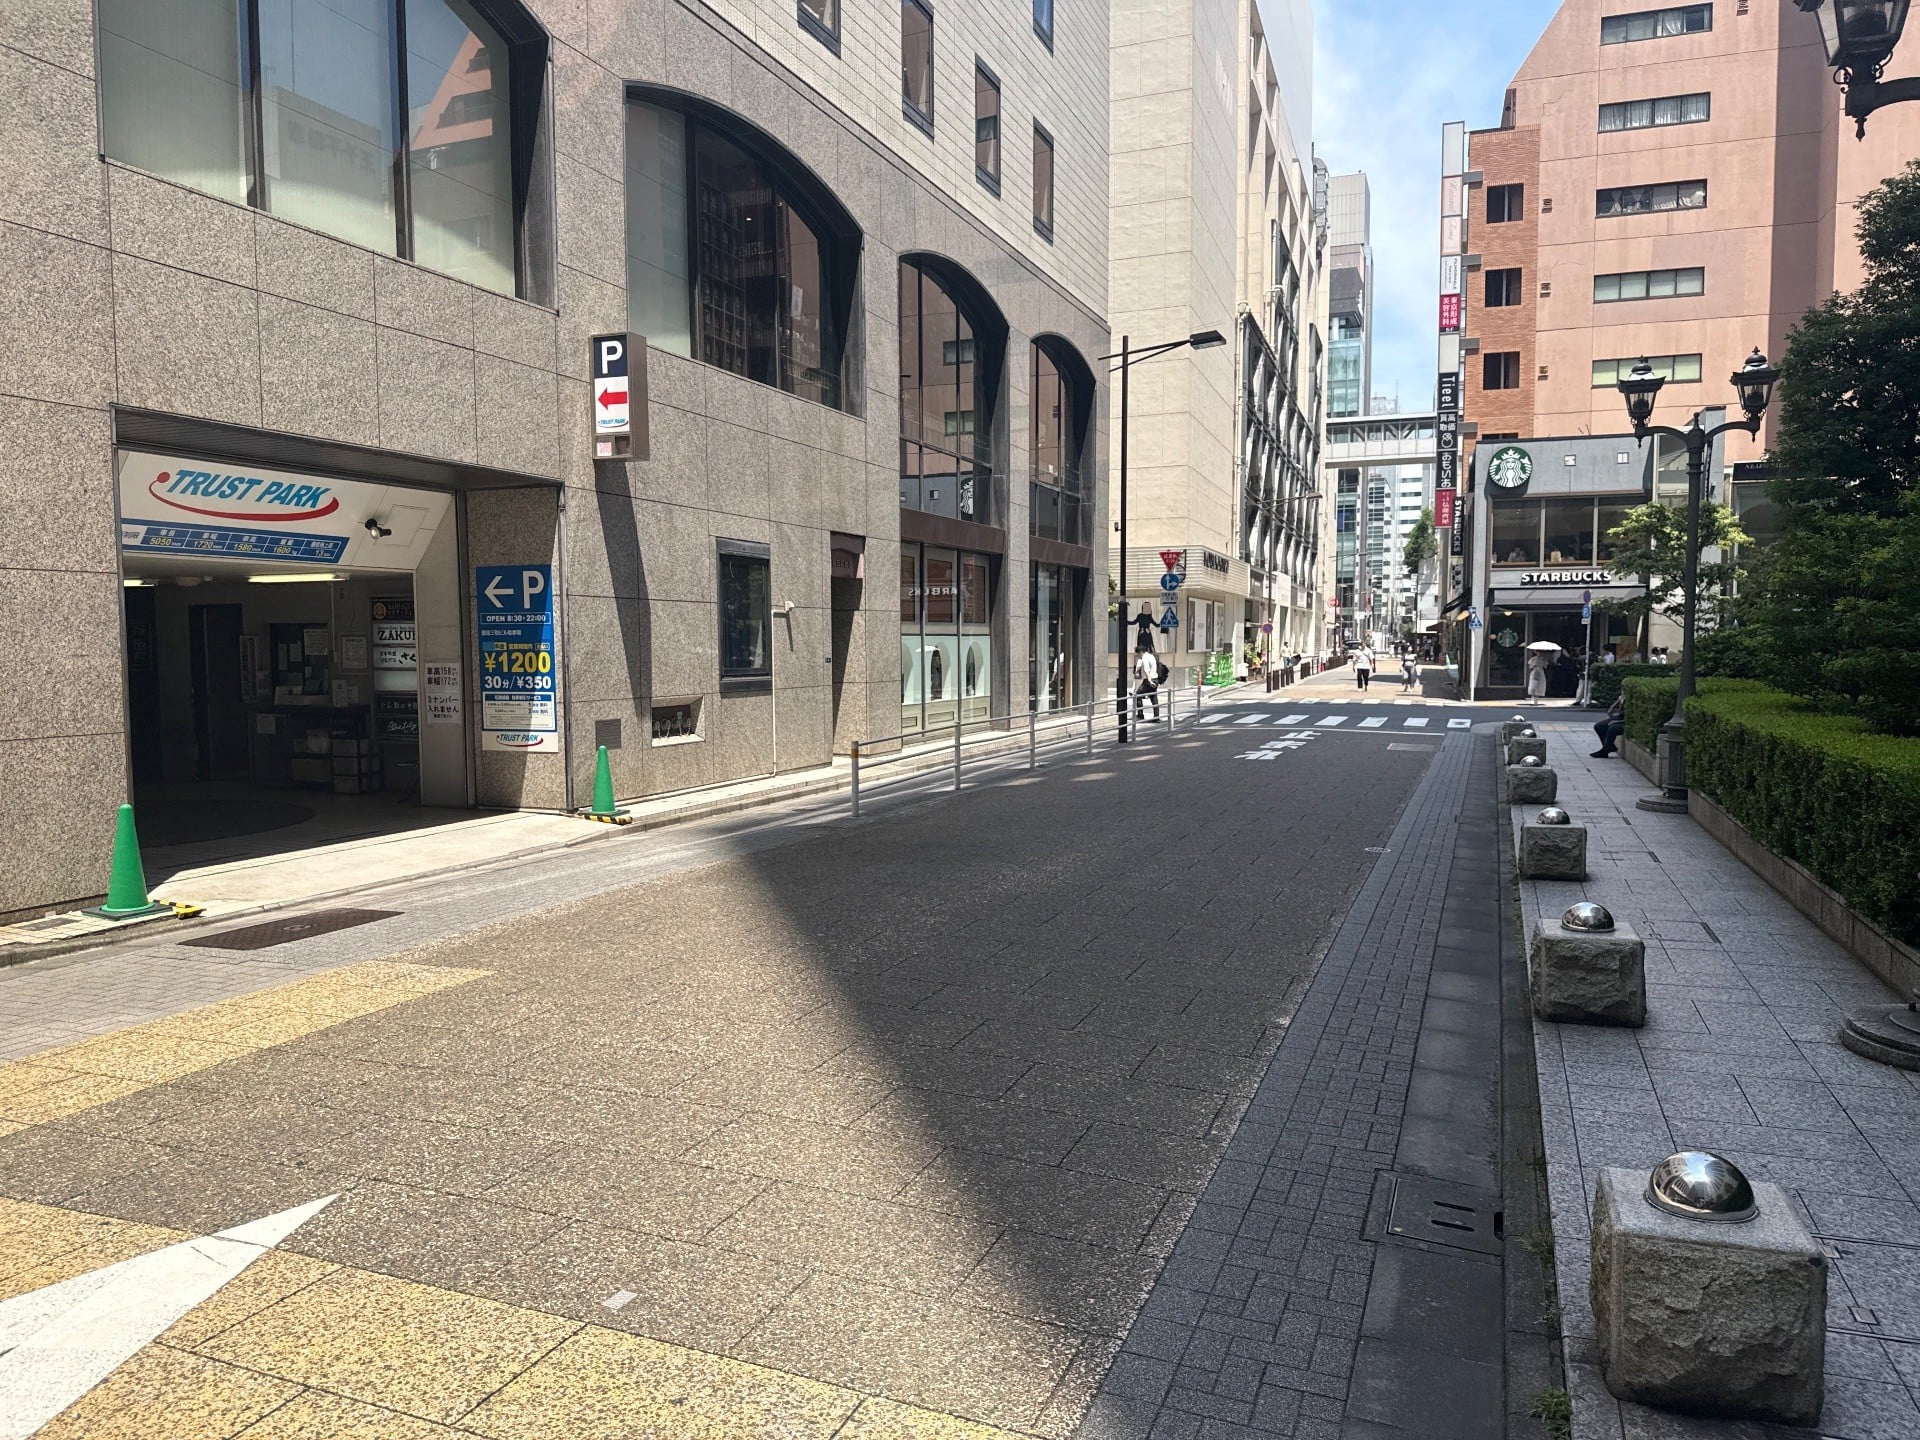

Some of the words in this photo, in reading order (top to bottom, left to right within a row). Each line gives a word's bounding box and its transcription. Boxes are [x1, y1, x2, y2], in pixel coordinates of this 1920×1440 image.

[1442, 297, 1450, 326] 美容外科
[1450, 296, 1458, 325] 東京形成
[601, 340, 623, 375] P
[1439, 413, 1448, 431] 買取
[1447, 413, 1456, 431] 高価
[166, 469, 265, 501] TRUST
[257, 481, 331, 509] PARK
[1453, 499, 1463, 553] STARBUCKS
[522, 570, 545, 609] P
[1521, 571, 1612, 583] STARBUCKS
[484, 651, 551, 674] ¥1200
[500, 734, 521, 742] TRUST
[521, 734, 540, 742] PARK
